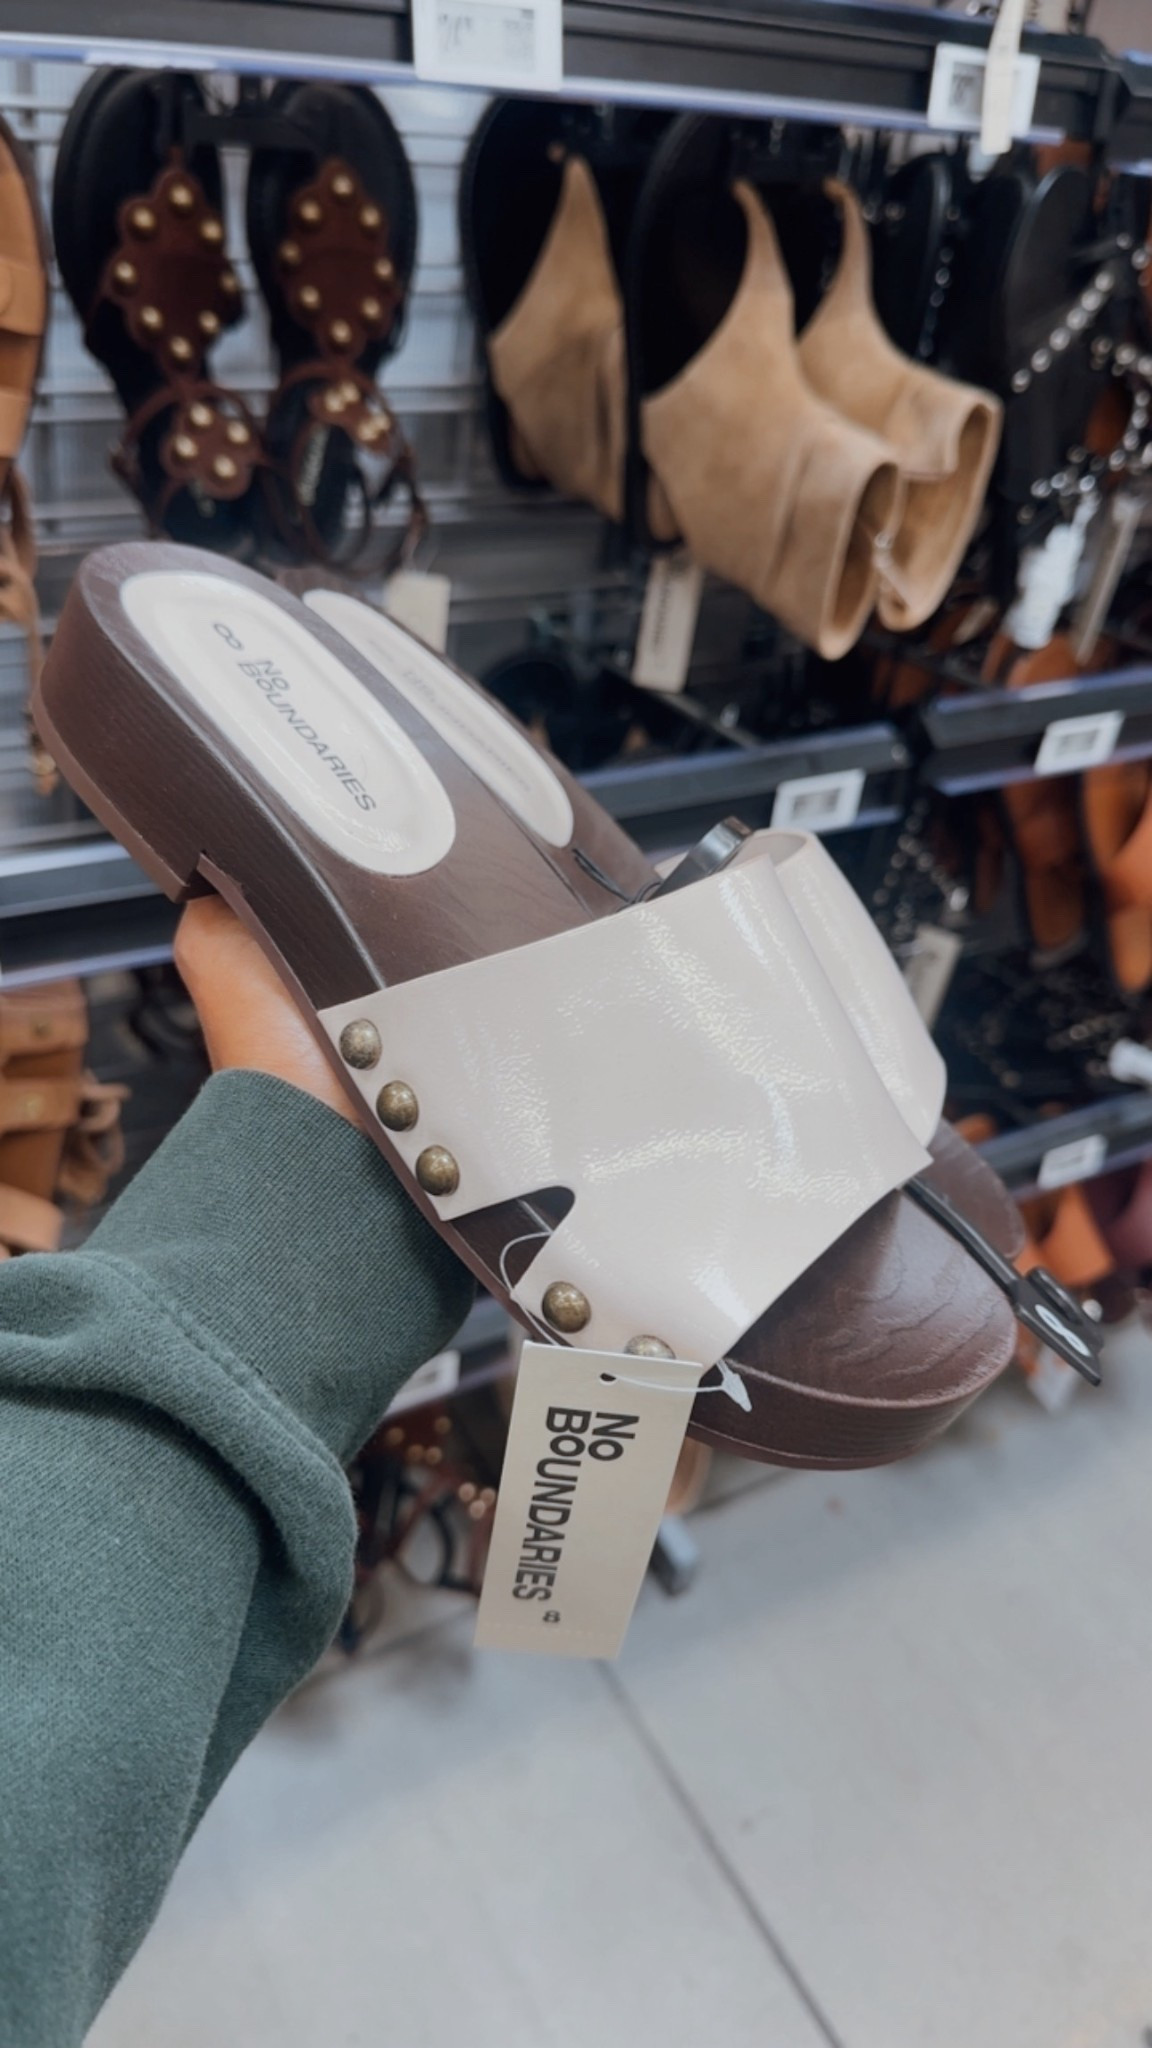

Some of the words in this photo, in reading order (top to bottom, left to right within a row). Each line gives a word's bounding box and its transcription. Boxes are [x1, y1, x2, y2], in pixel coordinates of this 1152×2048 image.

[213, 622, 244, 650] 8
[237, 661, 377, 811] BOUNDARIES
[512, 1406, 592, 1602] BOUNDARIES
